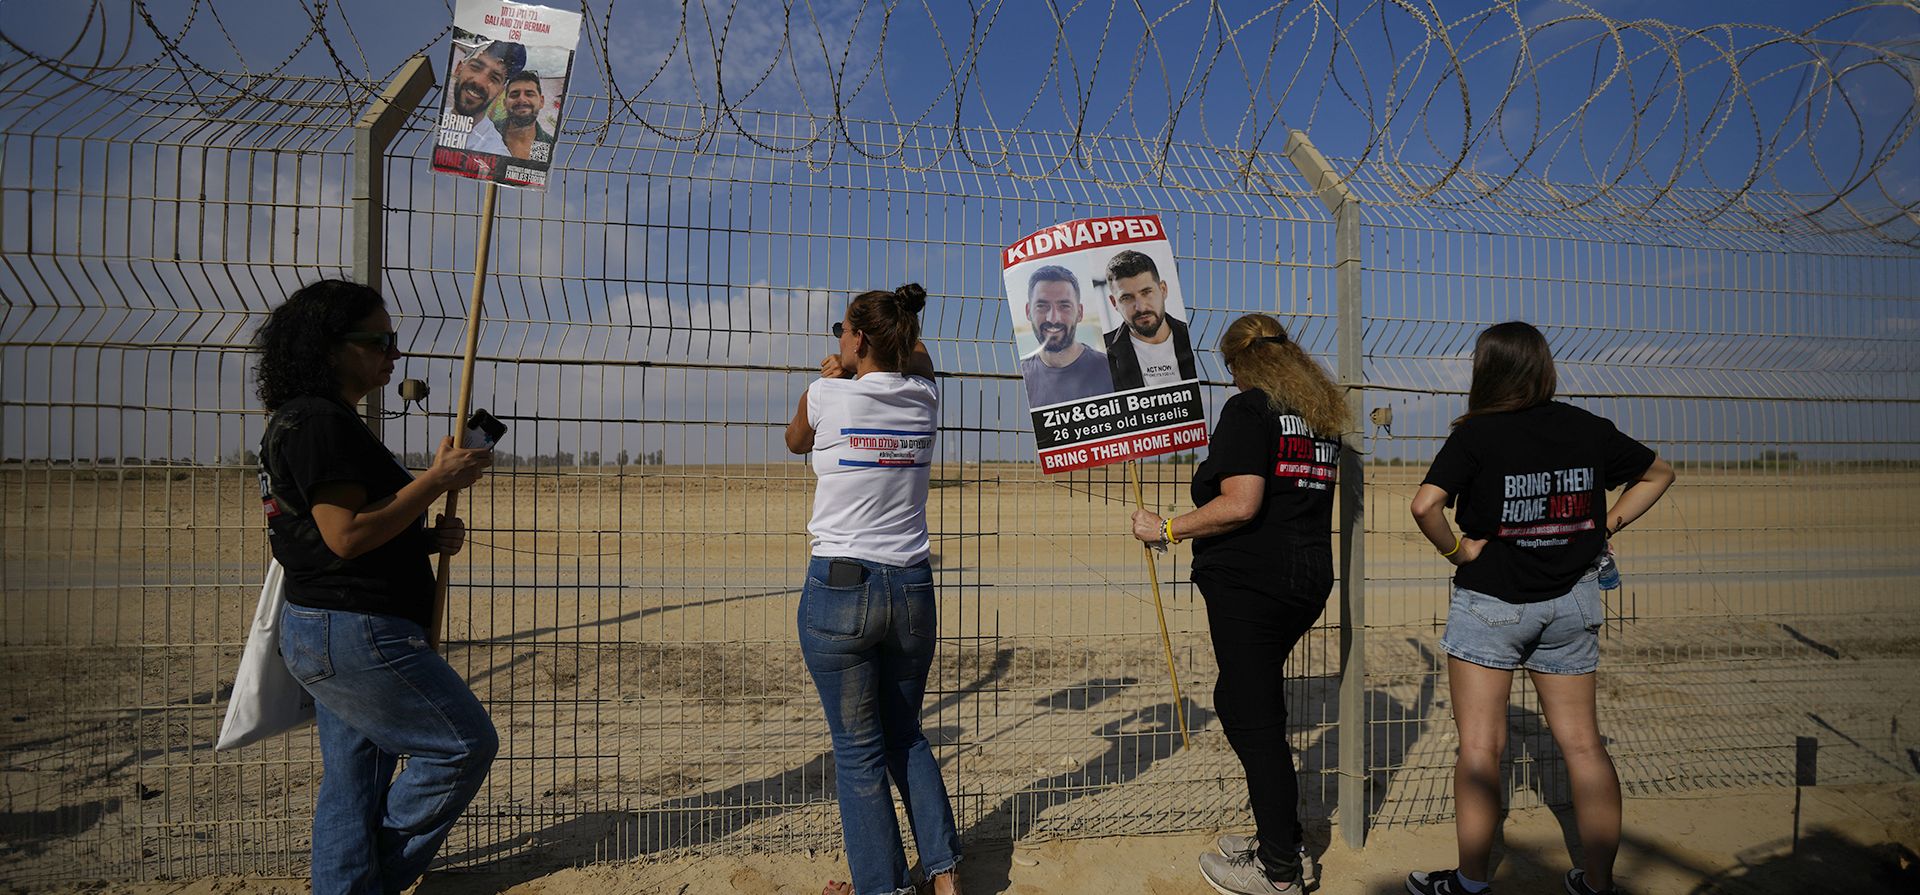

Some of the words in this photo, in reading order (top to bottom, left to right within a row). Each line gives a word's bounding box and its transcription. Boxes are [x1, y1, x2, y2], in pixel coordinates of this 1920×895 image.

[484, 14, 499, 26] GALI
[500, 17, 512, 28] AND
[513, 19, 523, 29] ZIV
[524, 21, 551, 34] BERMAN
[508, 29, 522, 41] (26)
[441, 113, 474, 133] BRING
[438, 130, 468, 150] THEM
[434, 148, 463, 168] HOME
[1007, 218, 1159, 264] KIDNAPPED
[1042, 399, 1121, 428] Ziv&Gali
[1126, 389, 1192, 412] Berman
[1053, 427, 1070, 441] 26
[1074, 422, 1112, 440] years
[1117, 415, 1137, 429] old
[1142, 407, 1189, 425] Israelis
[850, 436, 877, 448] חוזרים!
[878, 437, 899, 449] שכולם
[1045, 449, 1088, 469] BRING
[1091, 441, 1130, 460] THEM
[1133, 434, 1171, 453] HOME
[1173, 427, 1206, 445] NOW!
[1504, 472, 1551, 498] BRING
[1554, 467, 1594, 493] THEM
[1501, 498, 1548, 522] HOME
